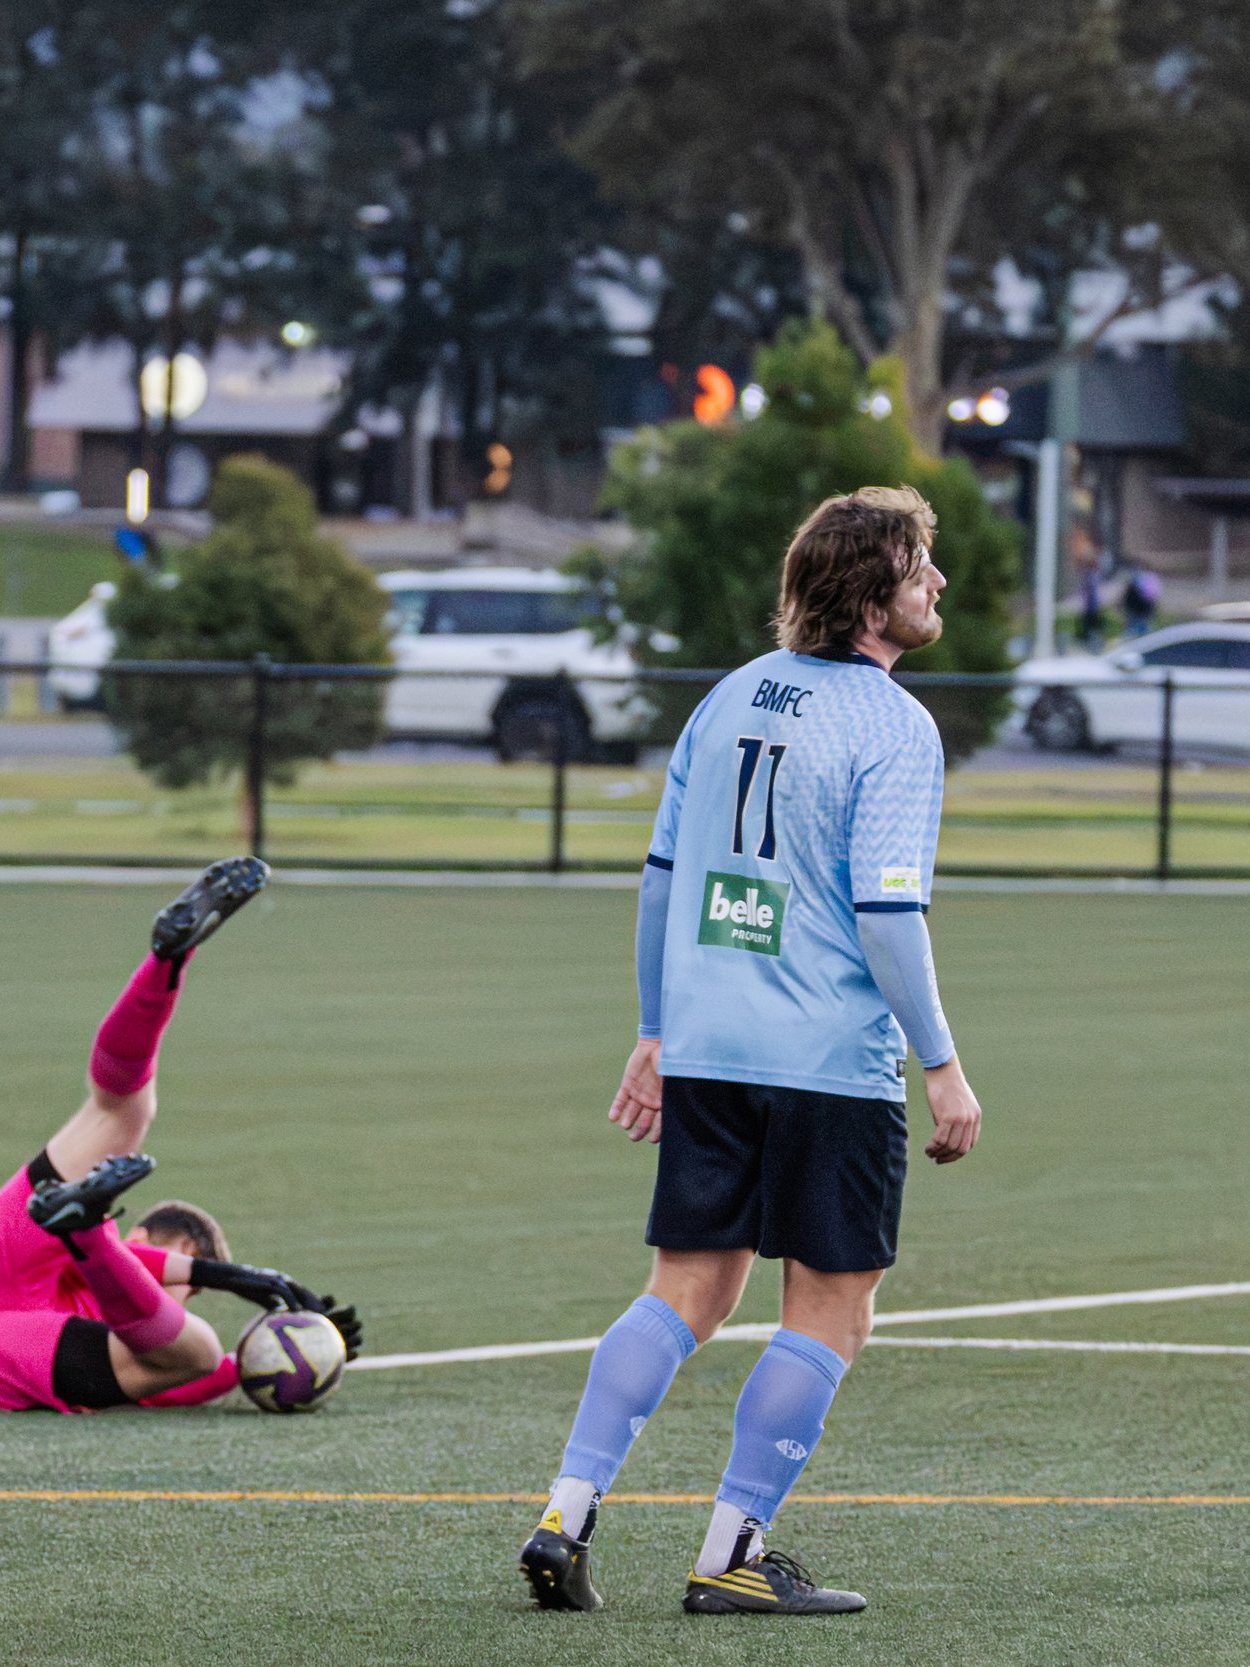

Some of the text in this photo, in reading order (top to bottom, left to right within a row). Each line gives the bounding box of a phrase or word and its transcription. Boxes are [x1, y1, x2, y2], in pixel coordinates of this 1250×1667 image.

[751, 678, 814, 718] BMFC
[732, 736, 788, 862] 11
[709, 881, 774, 928] belle
[731, 928, 772, 945] PROPERTY
